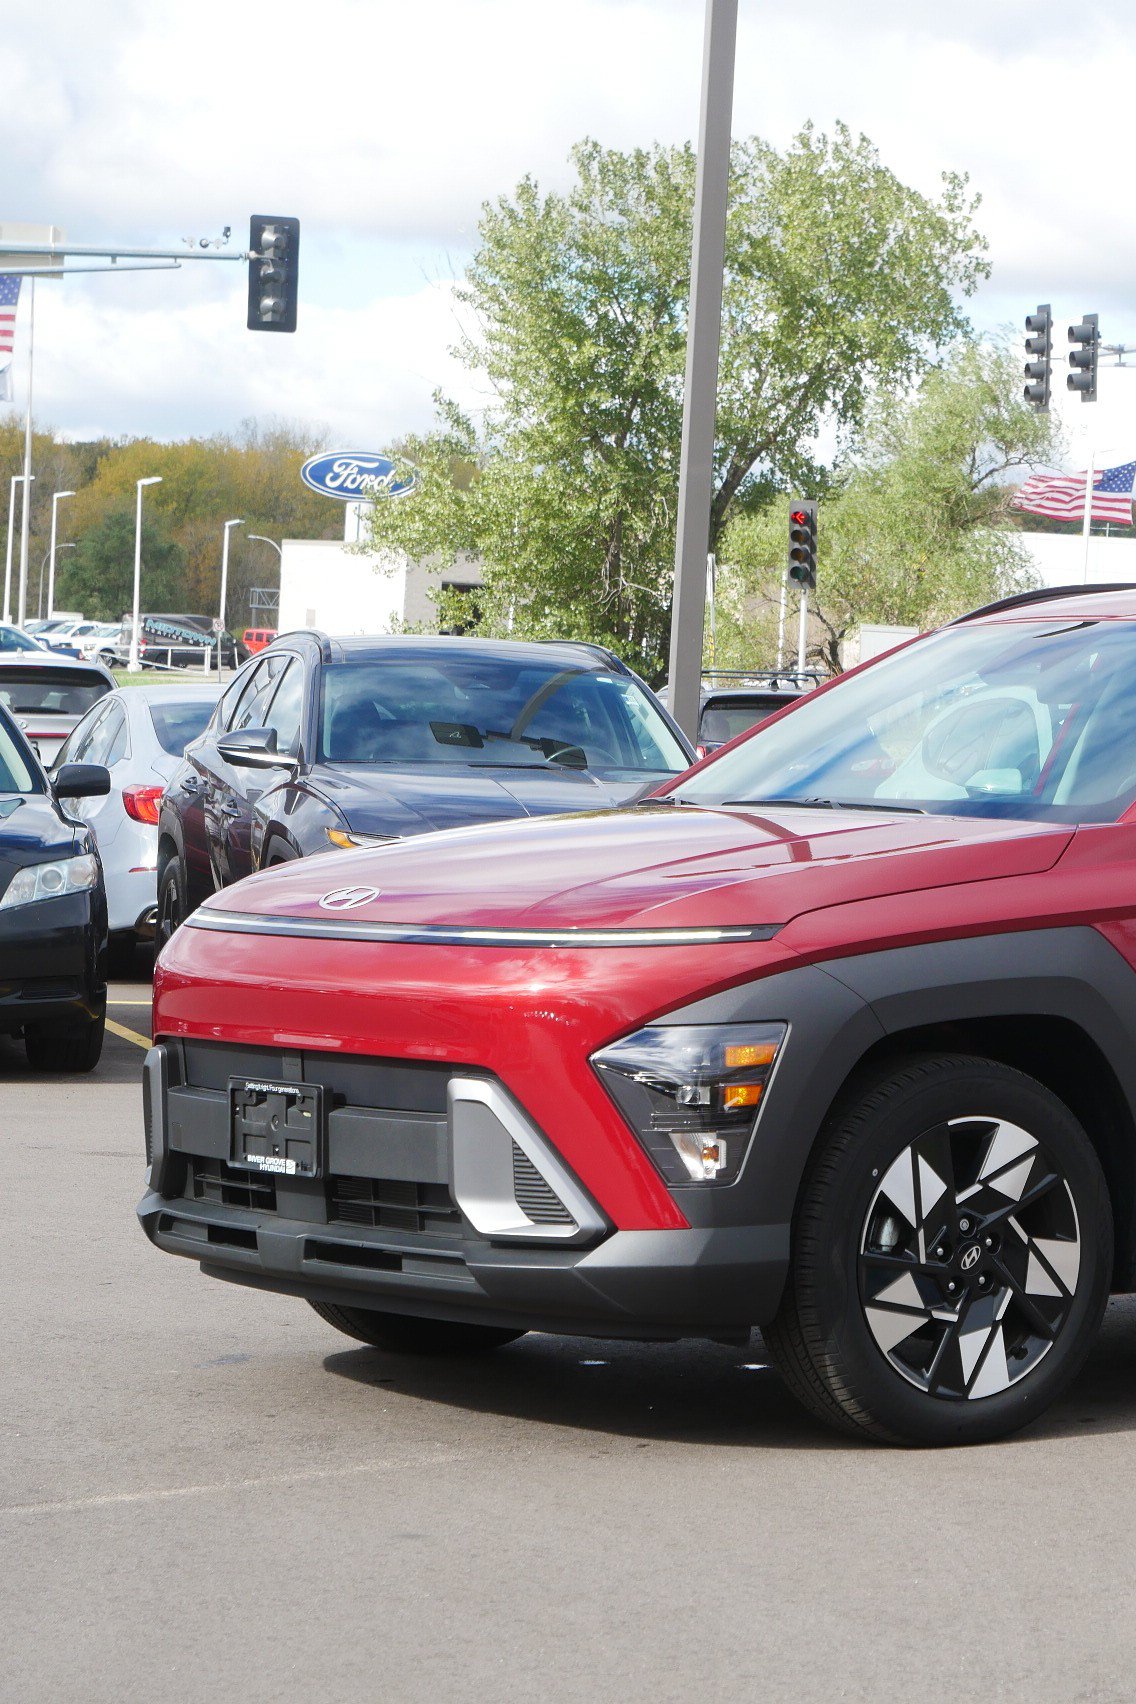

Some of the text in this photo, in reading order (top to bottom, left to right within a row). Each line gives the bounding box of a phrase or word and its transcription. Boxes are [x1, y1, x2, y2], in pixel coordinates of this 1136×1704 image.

[325, 458, 395, 489] Ford
[146, 619, 217, 647] MIDTOWN
[259, 1164, 286, 1173] HYUNDAI
[265, 1157, 286, 1166] GROVE
